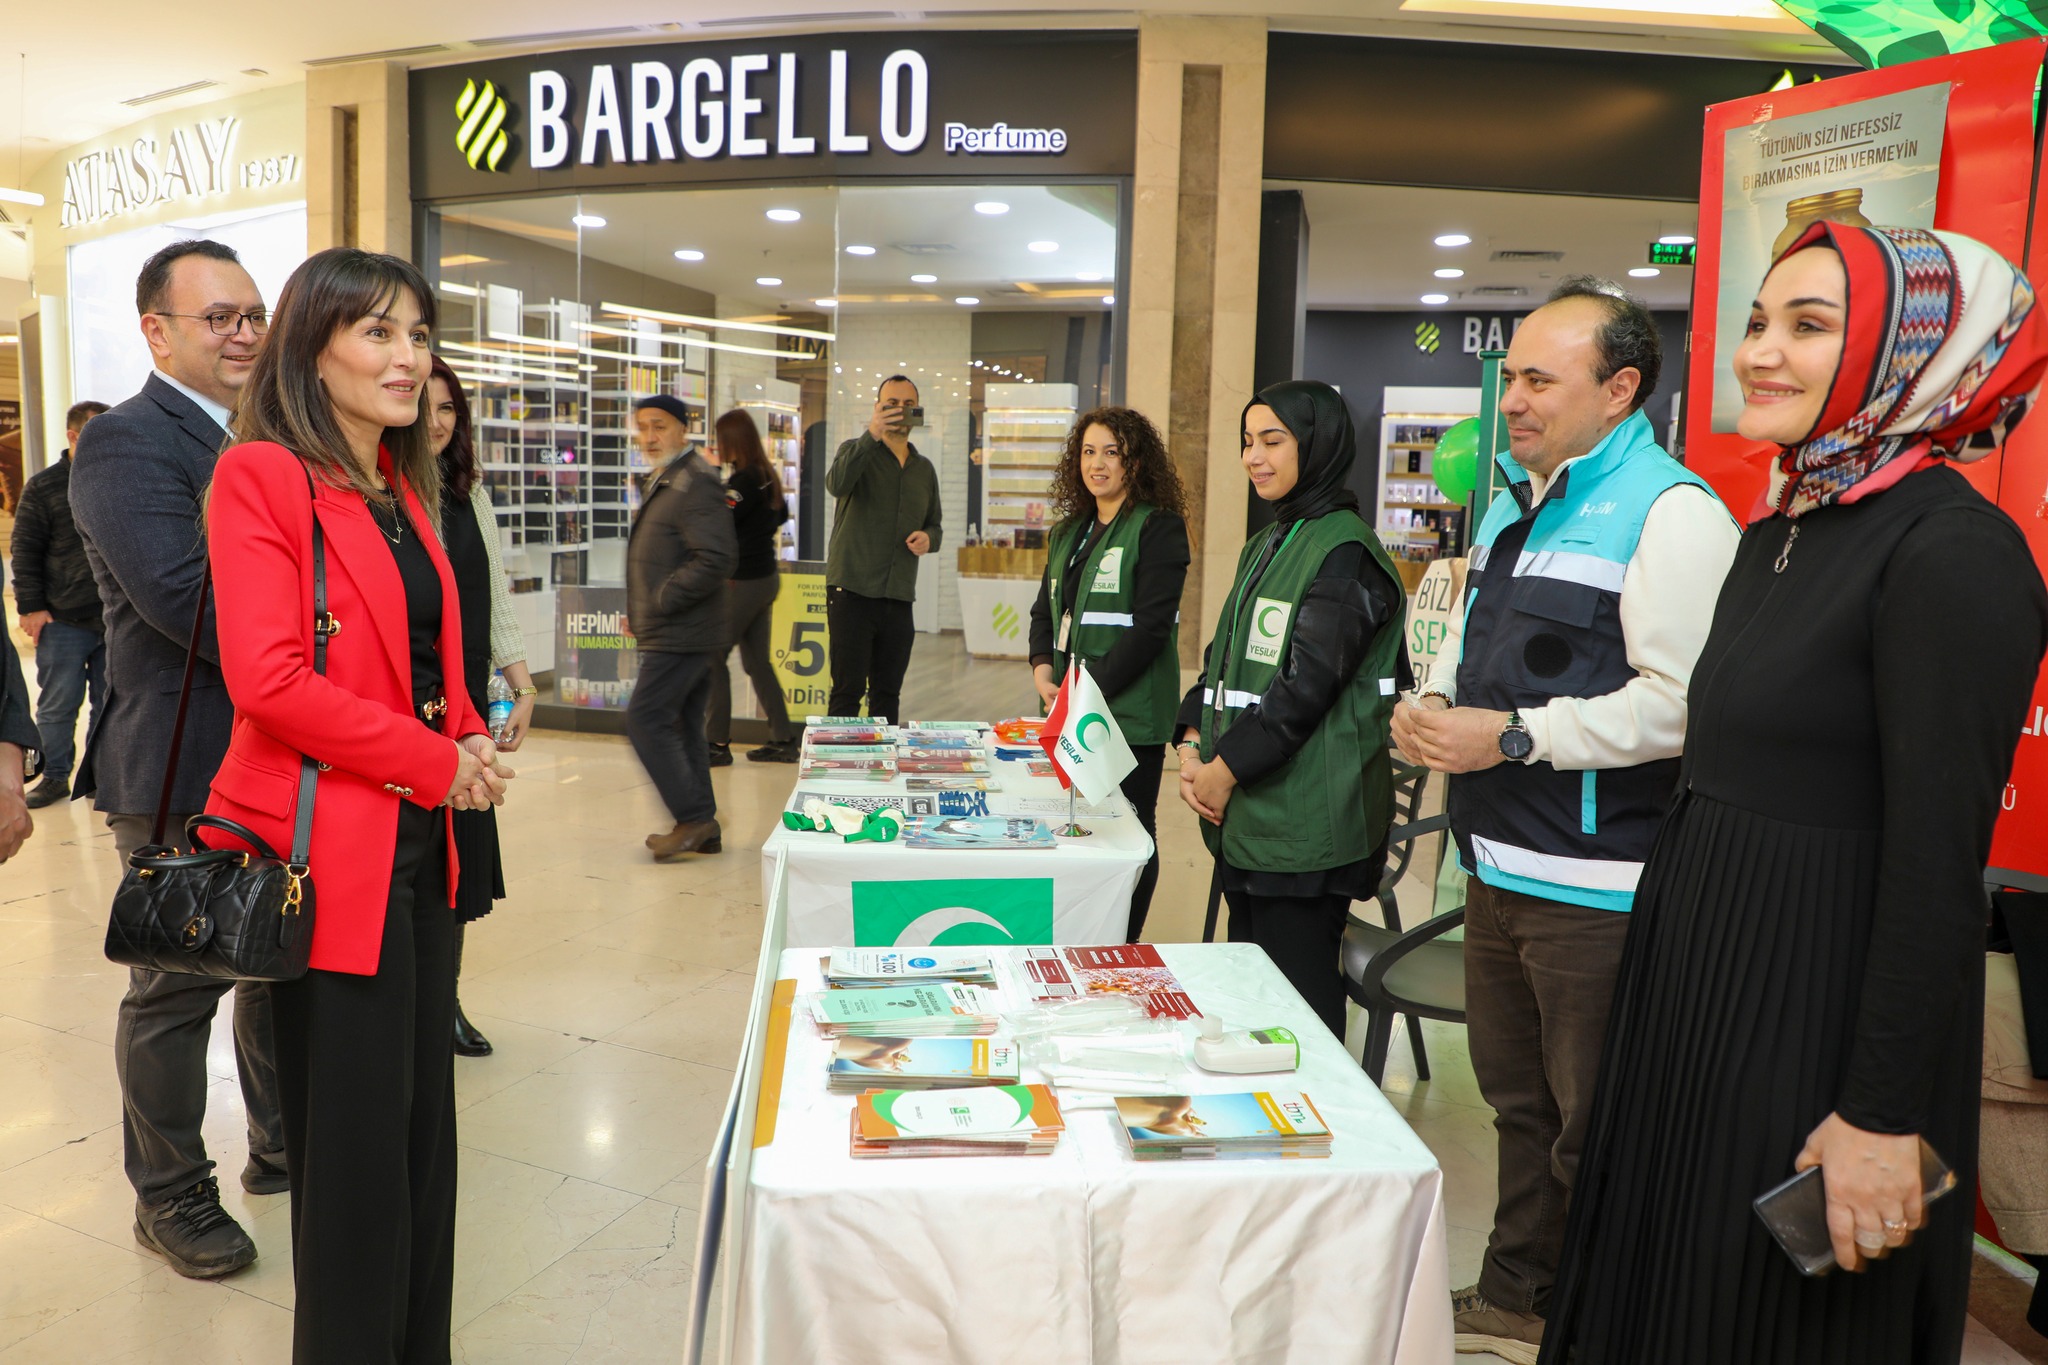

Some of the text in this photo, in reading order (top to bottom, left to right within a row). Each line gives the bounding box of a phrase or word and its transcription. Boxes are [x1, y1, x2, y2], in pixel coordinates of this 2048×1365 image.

[529, 49, 930, 169] BARGELLO
[945, 122, 1067, 152] Perfume
[1760, 112, 1903, 159] TÜTÜNÜN SİZİ NEFESSİZ
[59, 115, 300, 229] ATASAY 1937
[1742, 139, 1918, 191] BIRAKMASINA İZİN VERMEYİN
[1653, 254, 1681, 264] EXIT
[1463, 316, 1524, 353] BA
[1417, 571, 1450, 612] BİZ
[573, 636, 623, 649] NUMARASI
[1250, 644, 1278, 658] YEŞİLAY
[1059, 733, 1083, 765] YEŞİLAY
